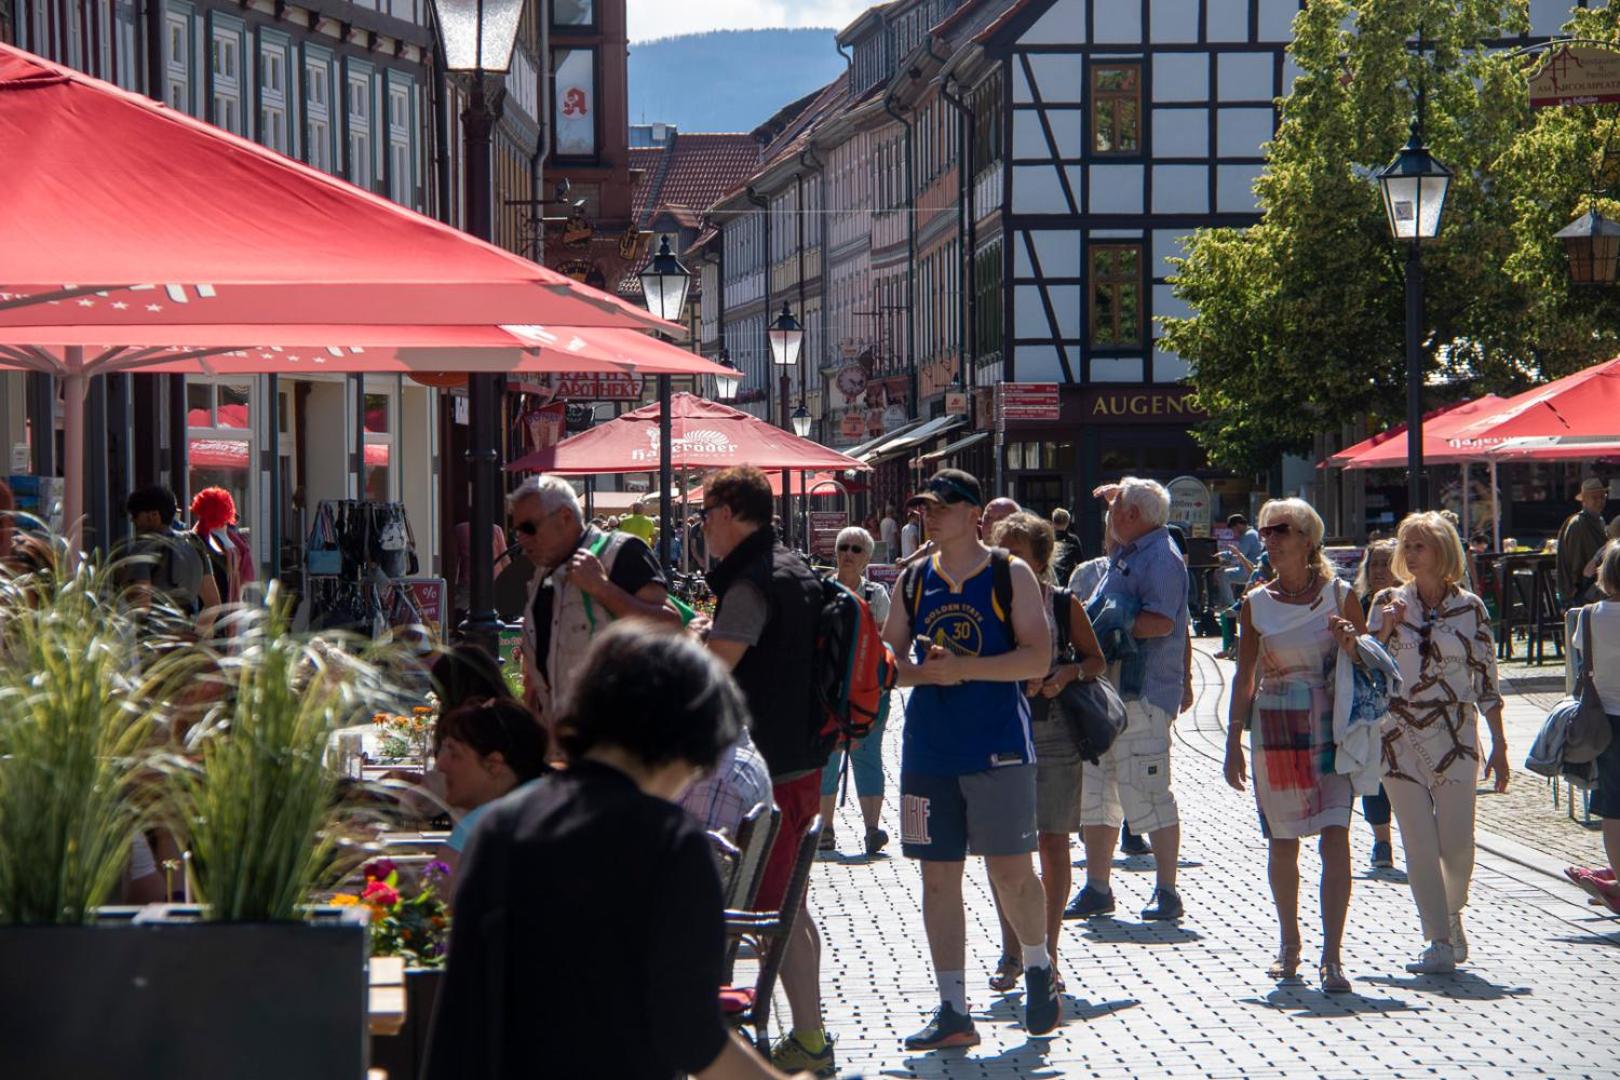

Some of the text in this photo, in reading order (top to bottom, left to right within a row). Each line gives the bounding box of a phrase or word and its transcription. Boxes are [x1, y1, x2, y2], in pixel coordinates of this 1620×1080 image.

[556, 381, 640, 397] APOTHEKE
[924, 603, 984, 624] GOLDEN STATE
[952, 622, 970, 640] 30
